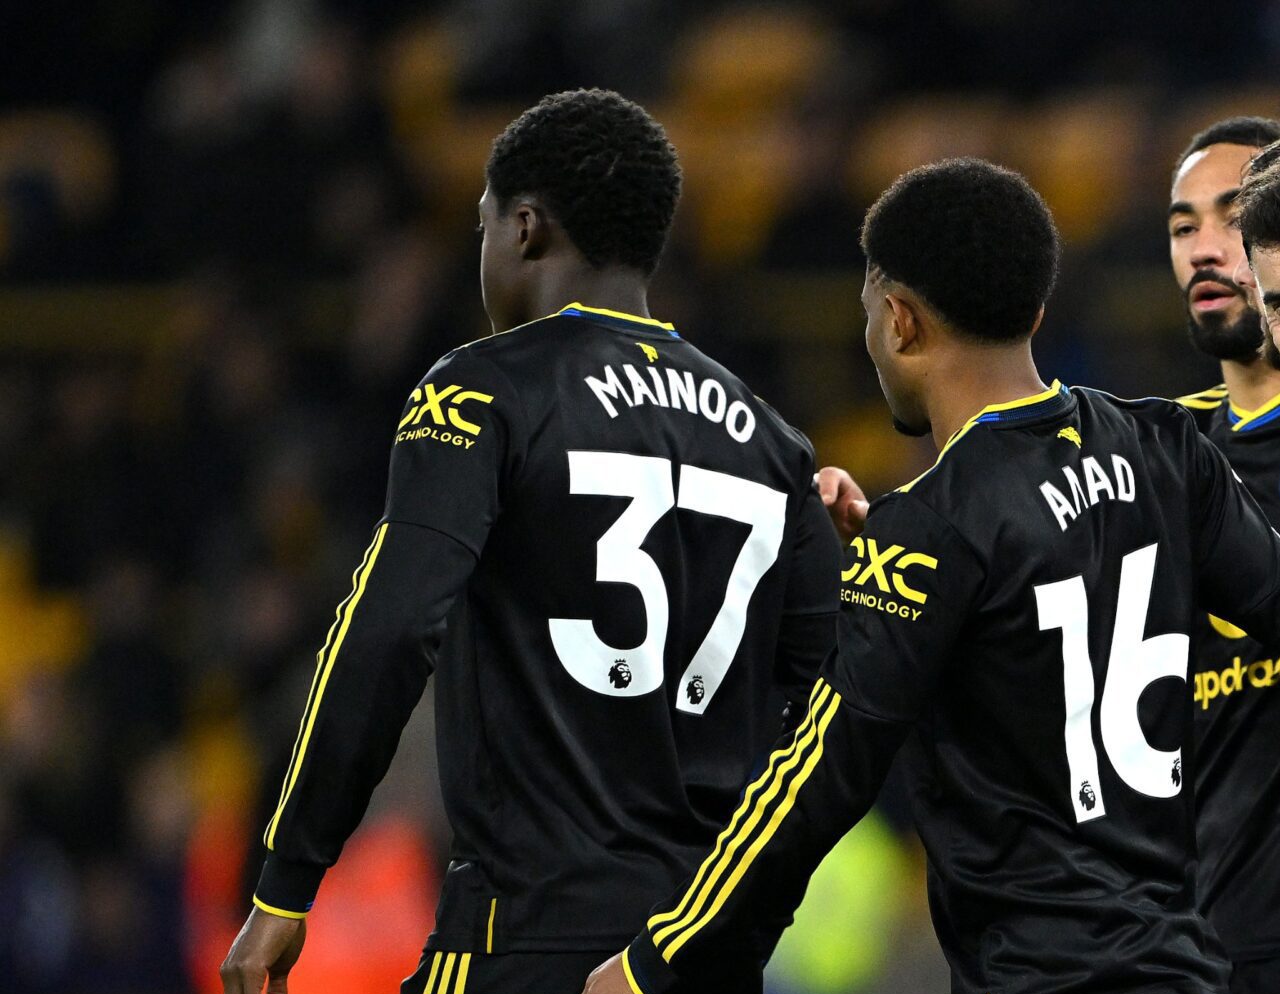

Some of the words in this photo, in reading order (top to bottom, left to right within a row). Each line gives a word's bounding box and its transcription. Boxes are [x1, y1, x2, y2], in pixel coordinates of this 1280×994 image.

[585, 364, 756, 443] MAINOO
[549, 450, 788, 715] 37
[841, 588, 922, 621] ECHNOLOGY
[1034, 542, 1190, 823] 16
